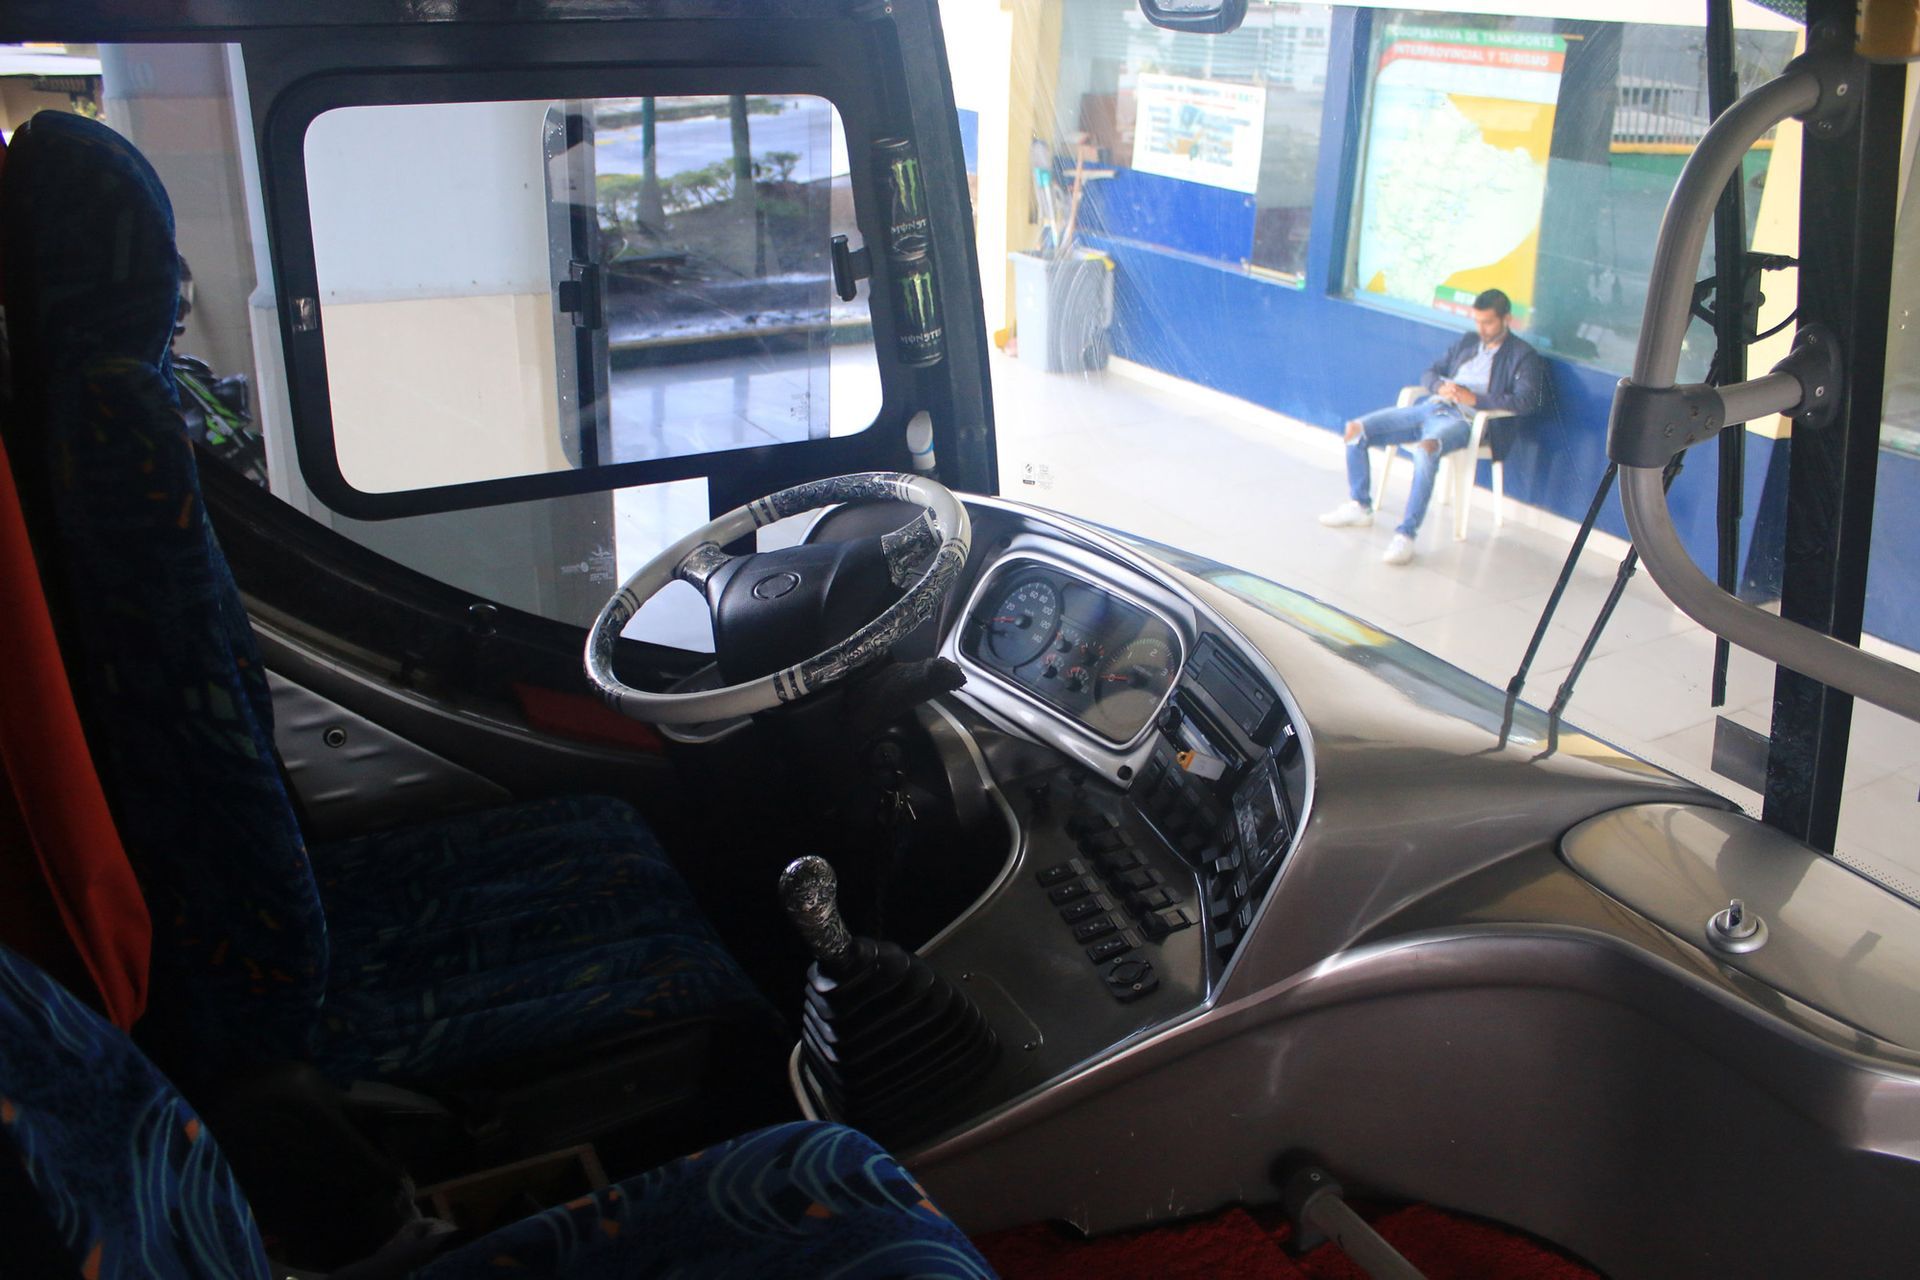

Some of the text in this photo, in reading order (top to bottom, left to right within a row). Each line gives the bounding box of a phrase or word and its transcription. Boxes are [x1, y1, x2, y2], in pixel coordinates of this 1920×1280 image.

[1466, 31, 1480, 42] DE
[1484, 32, 1556, 48] TRANSPORTE
[1394, 45, 1550, 66] INTERPROVINCIAL Y TURISMO
[891, 219, 927, 233] MONST
[1150, 648, 1159, 657] 2
[1161, 667, 1169, 677] 3
